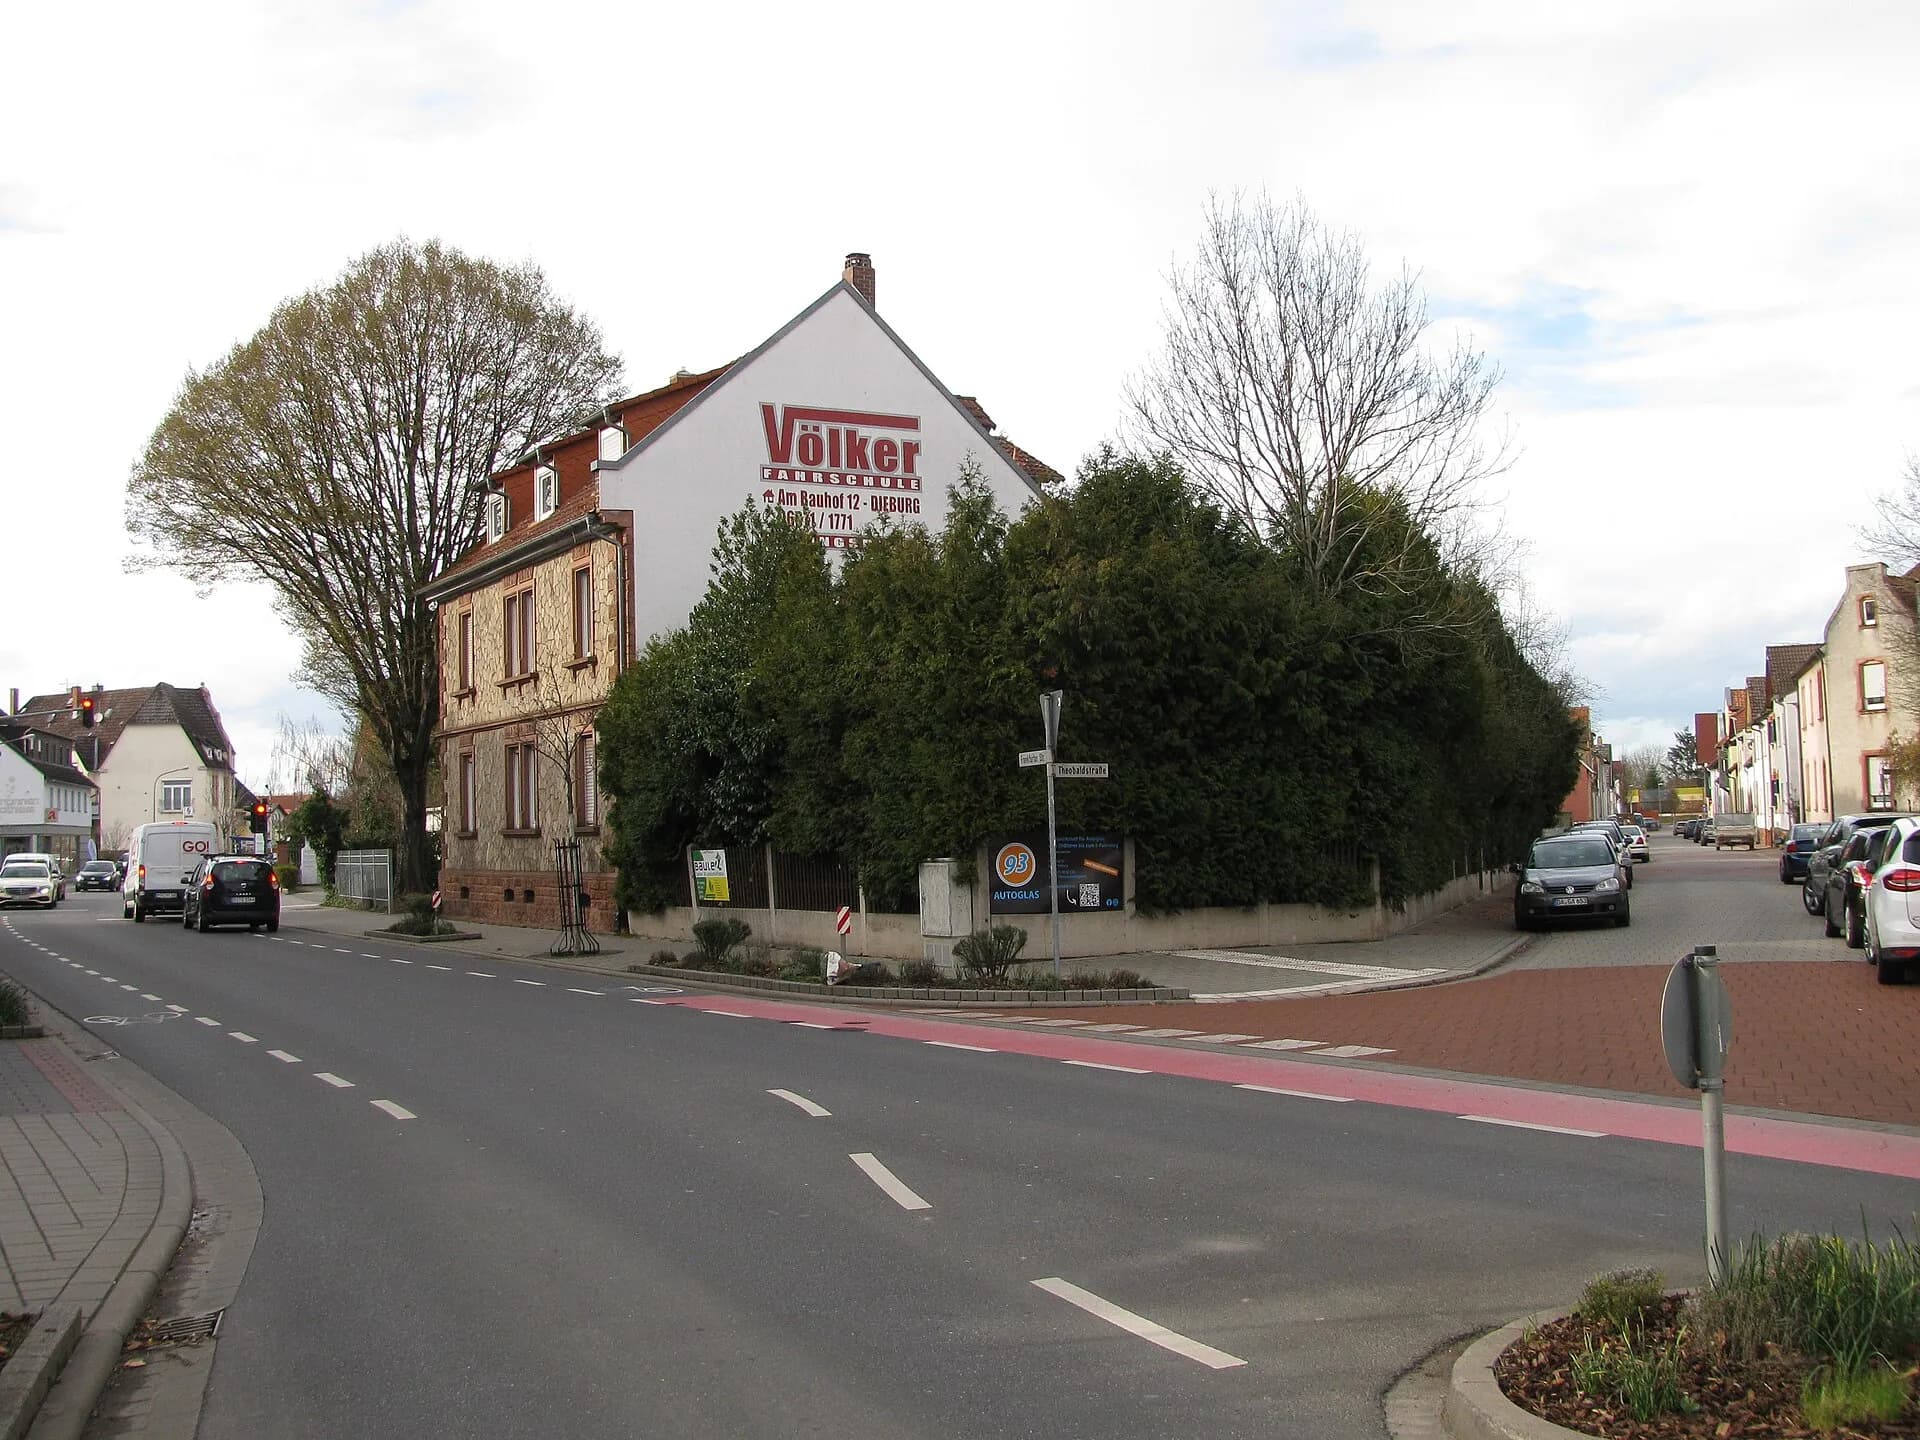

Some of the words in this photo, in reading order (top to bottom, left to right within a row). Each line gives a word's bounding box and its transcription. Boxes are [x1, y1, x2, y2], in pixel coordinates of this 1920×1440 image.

[760, 403, 921, 475] Völker
[762, 468, 919, 490] FAHRSCHULE
[778, 488, 797, 507] Am
[800, 490, 844, 510] Bauhof
[847, 494, 860, 510] 12
[871, 495, 921, 514] DIEBURG
[828, 513, 853, 531] 1771
[1058, 766, 1107, 775] Theobaldstraße
[182, 840, 209, 853] GO!
[1004, 853, 1028, 876] 93
[994, 890, 1041, 900] AUTOGLAS
